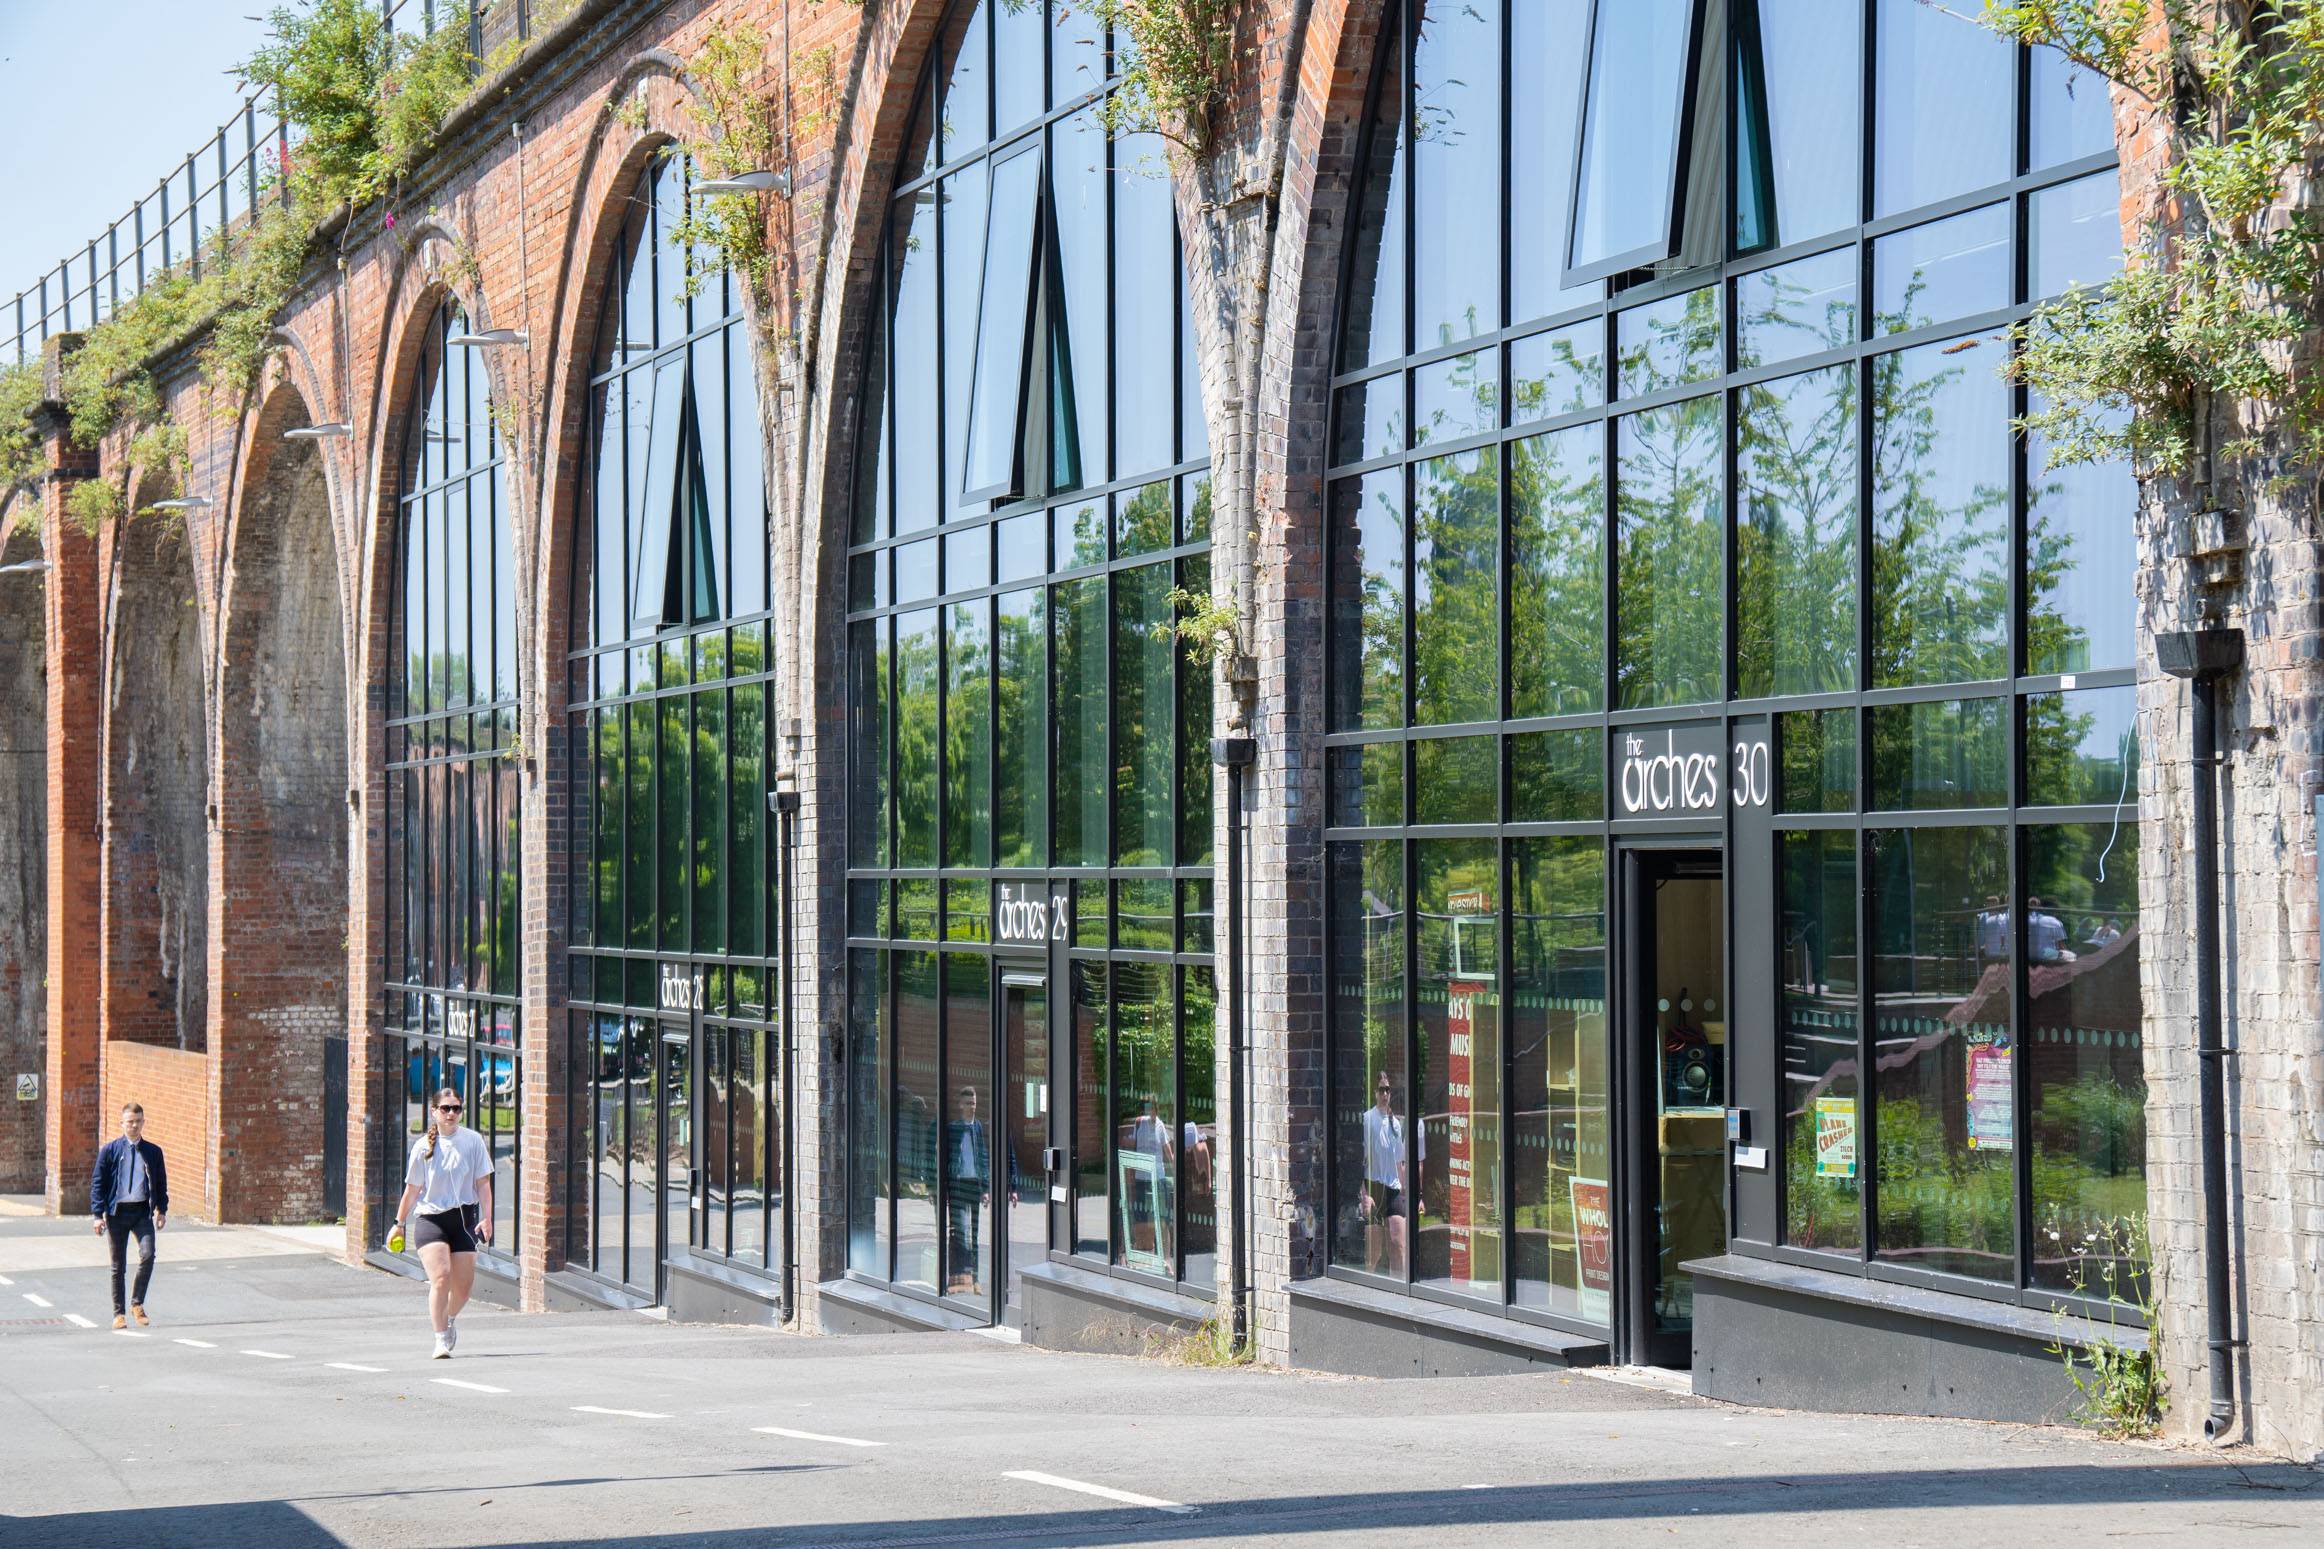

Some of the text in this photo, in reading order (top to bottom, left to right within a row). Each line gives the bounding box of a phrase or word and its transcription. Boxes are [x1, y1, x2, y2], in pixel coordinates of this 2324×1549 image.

[1626, 732, 1644, 756] the
[1622, 729, 1768, 813] arches 30
[999, 882, 1068, 942] arches 29
[661, 963, 691, 1009] arches
